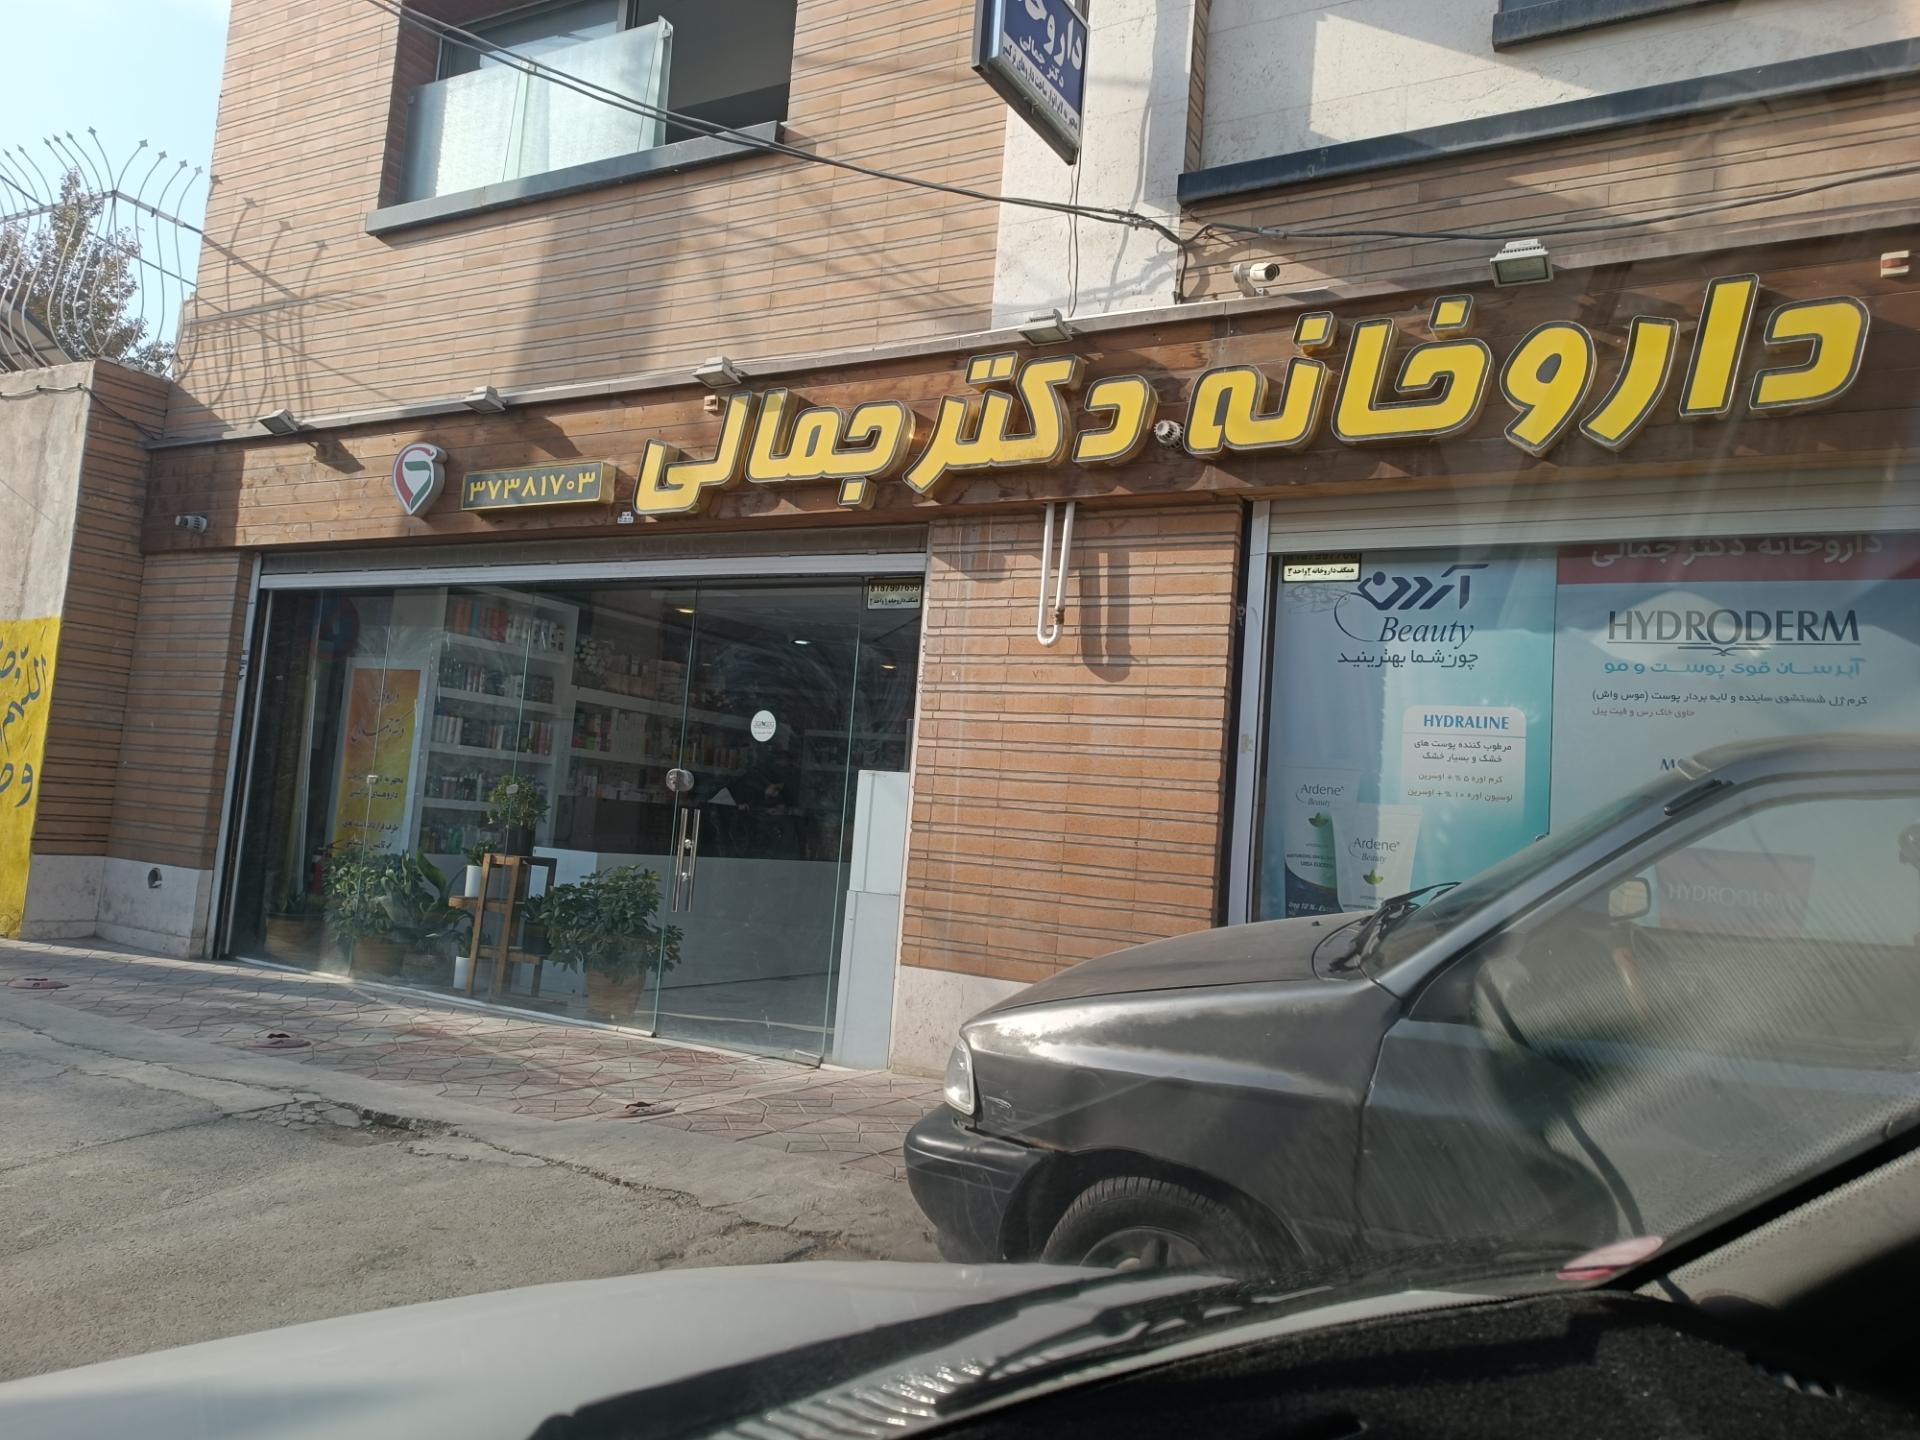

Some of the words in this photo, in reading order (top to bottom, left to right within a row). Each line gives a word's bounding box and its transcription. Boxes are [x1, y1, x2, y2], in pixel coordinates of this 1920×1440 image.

[1019, 35, 1046, 70] جمالی
[1046, 64, 1064, 88] دکتر
[1186, 273, 1872, 456] داروخانه
[902, 351, 1158, 494] دکتر
[633, 386, 914, 513] جمالی
[469, 471, 596, 501] ۳۷۳۸۱۷۰۳
[1378, 616, 1474, 650] Beauty
[1608, 609, 1860, 645] HYDRODERM
[1411, 649, 1444, 664] شما
[1441, 652, 1479, 670] چون
[1604, 662, 1629, 674] مو
[1634, 662, 1646, 675] و
[1650, 662, 1726, 679] پوست
[1730, 661, 1771, 677] قوی
[1776, 657, 1867, 679] آبرسان
[1651, 691, 1682, 703] پوست
[1847, 695, 1869, 707] کرم
[1423, 714, 1510, 730] HYDRALINE
[1483, 742, 1512, 752] مرطوب
[1422, 752, 1445, 760] خشک
[1479, 754, 1503, 763] خشک
